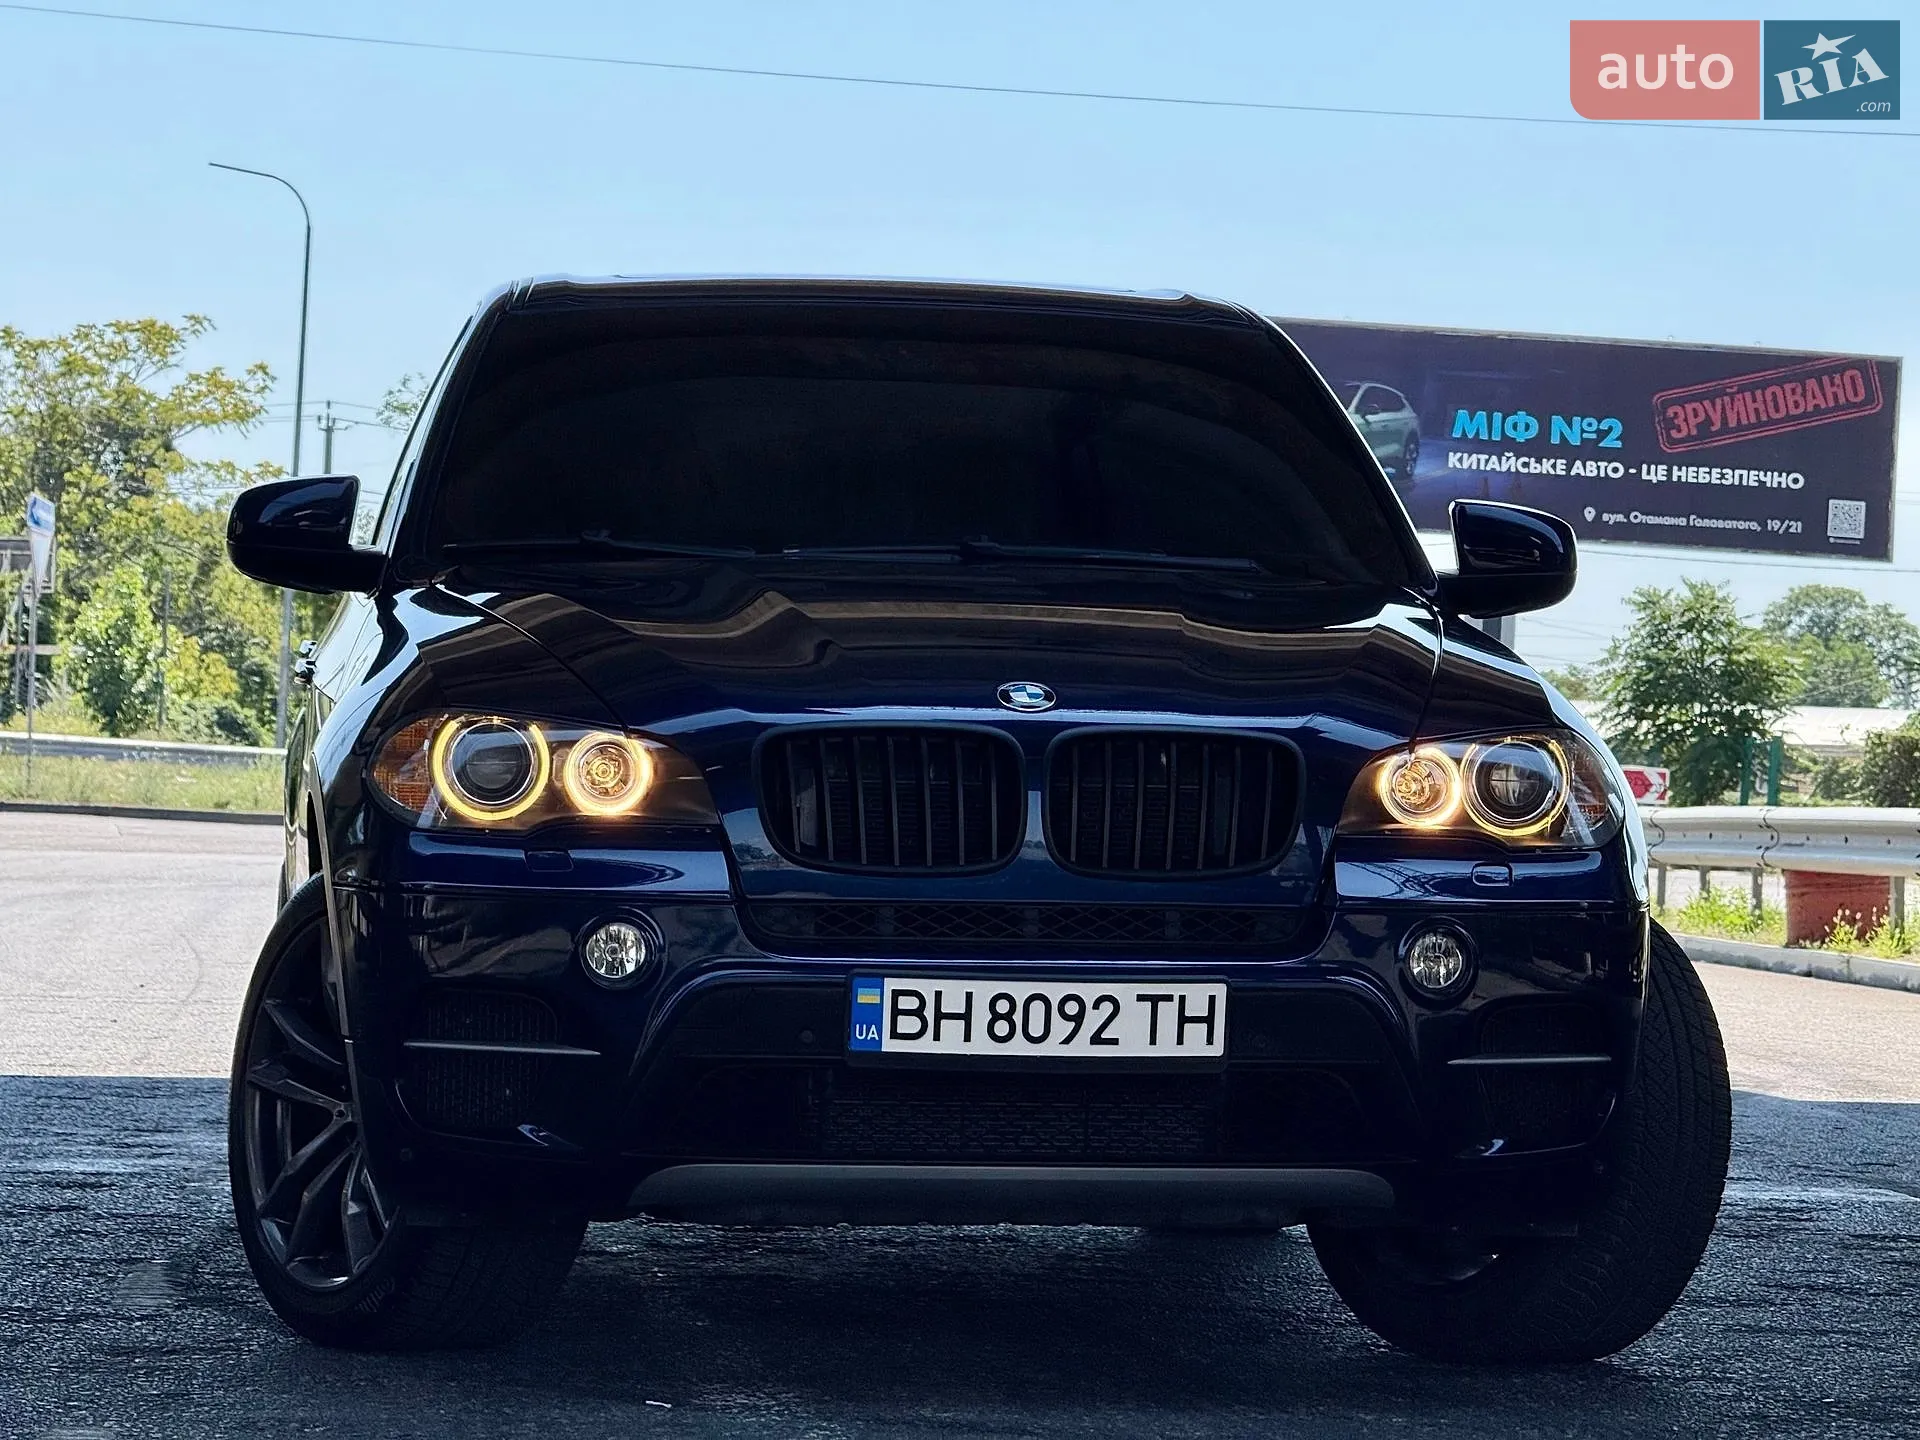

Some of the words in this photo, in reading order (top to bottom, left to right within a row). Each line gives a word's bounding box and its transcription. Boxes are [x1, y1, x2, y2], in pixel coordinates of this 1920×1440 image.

[1666, 368, 1866, 439] ЗРУЙНОВАНО
[1452, 409, 1539, 442] МІФ
[1448, 451, 1567, 476] КИТАЙСЬКЕ
[1570, 460, 1625, 479] АВТО
[1641, 463, 1668, 484] ЦЕ
[1672, 465, 1805, 490] НЕБЕЗПЕЧНО
[1629, 511, 1687, 526] Отамана
[1767, 518, 1803, 534] 19/21
[855, 1024, 879, 1041] UA
[888, 988, 974, 1043] BH
[986, 992, 1122, 1046] 8092
[1135, 993, 1216, 1046] TH
